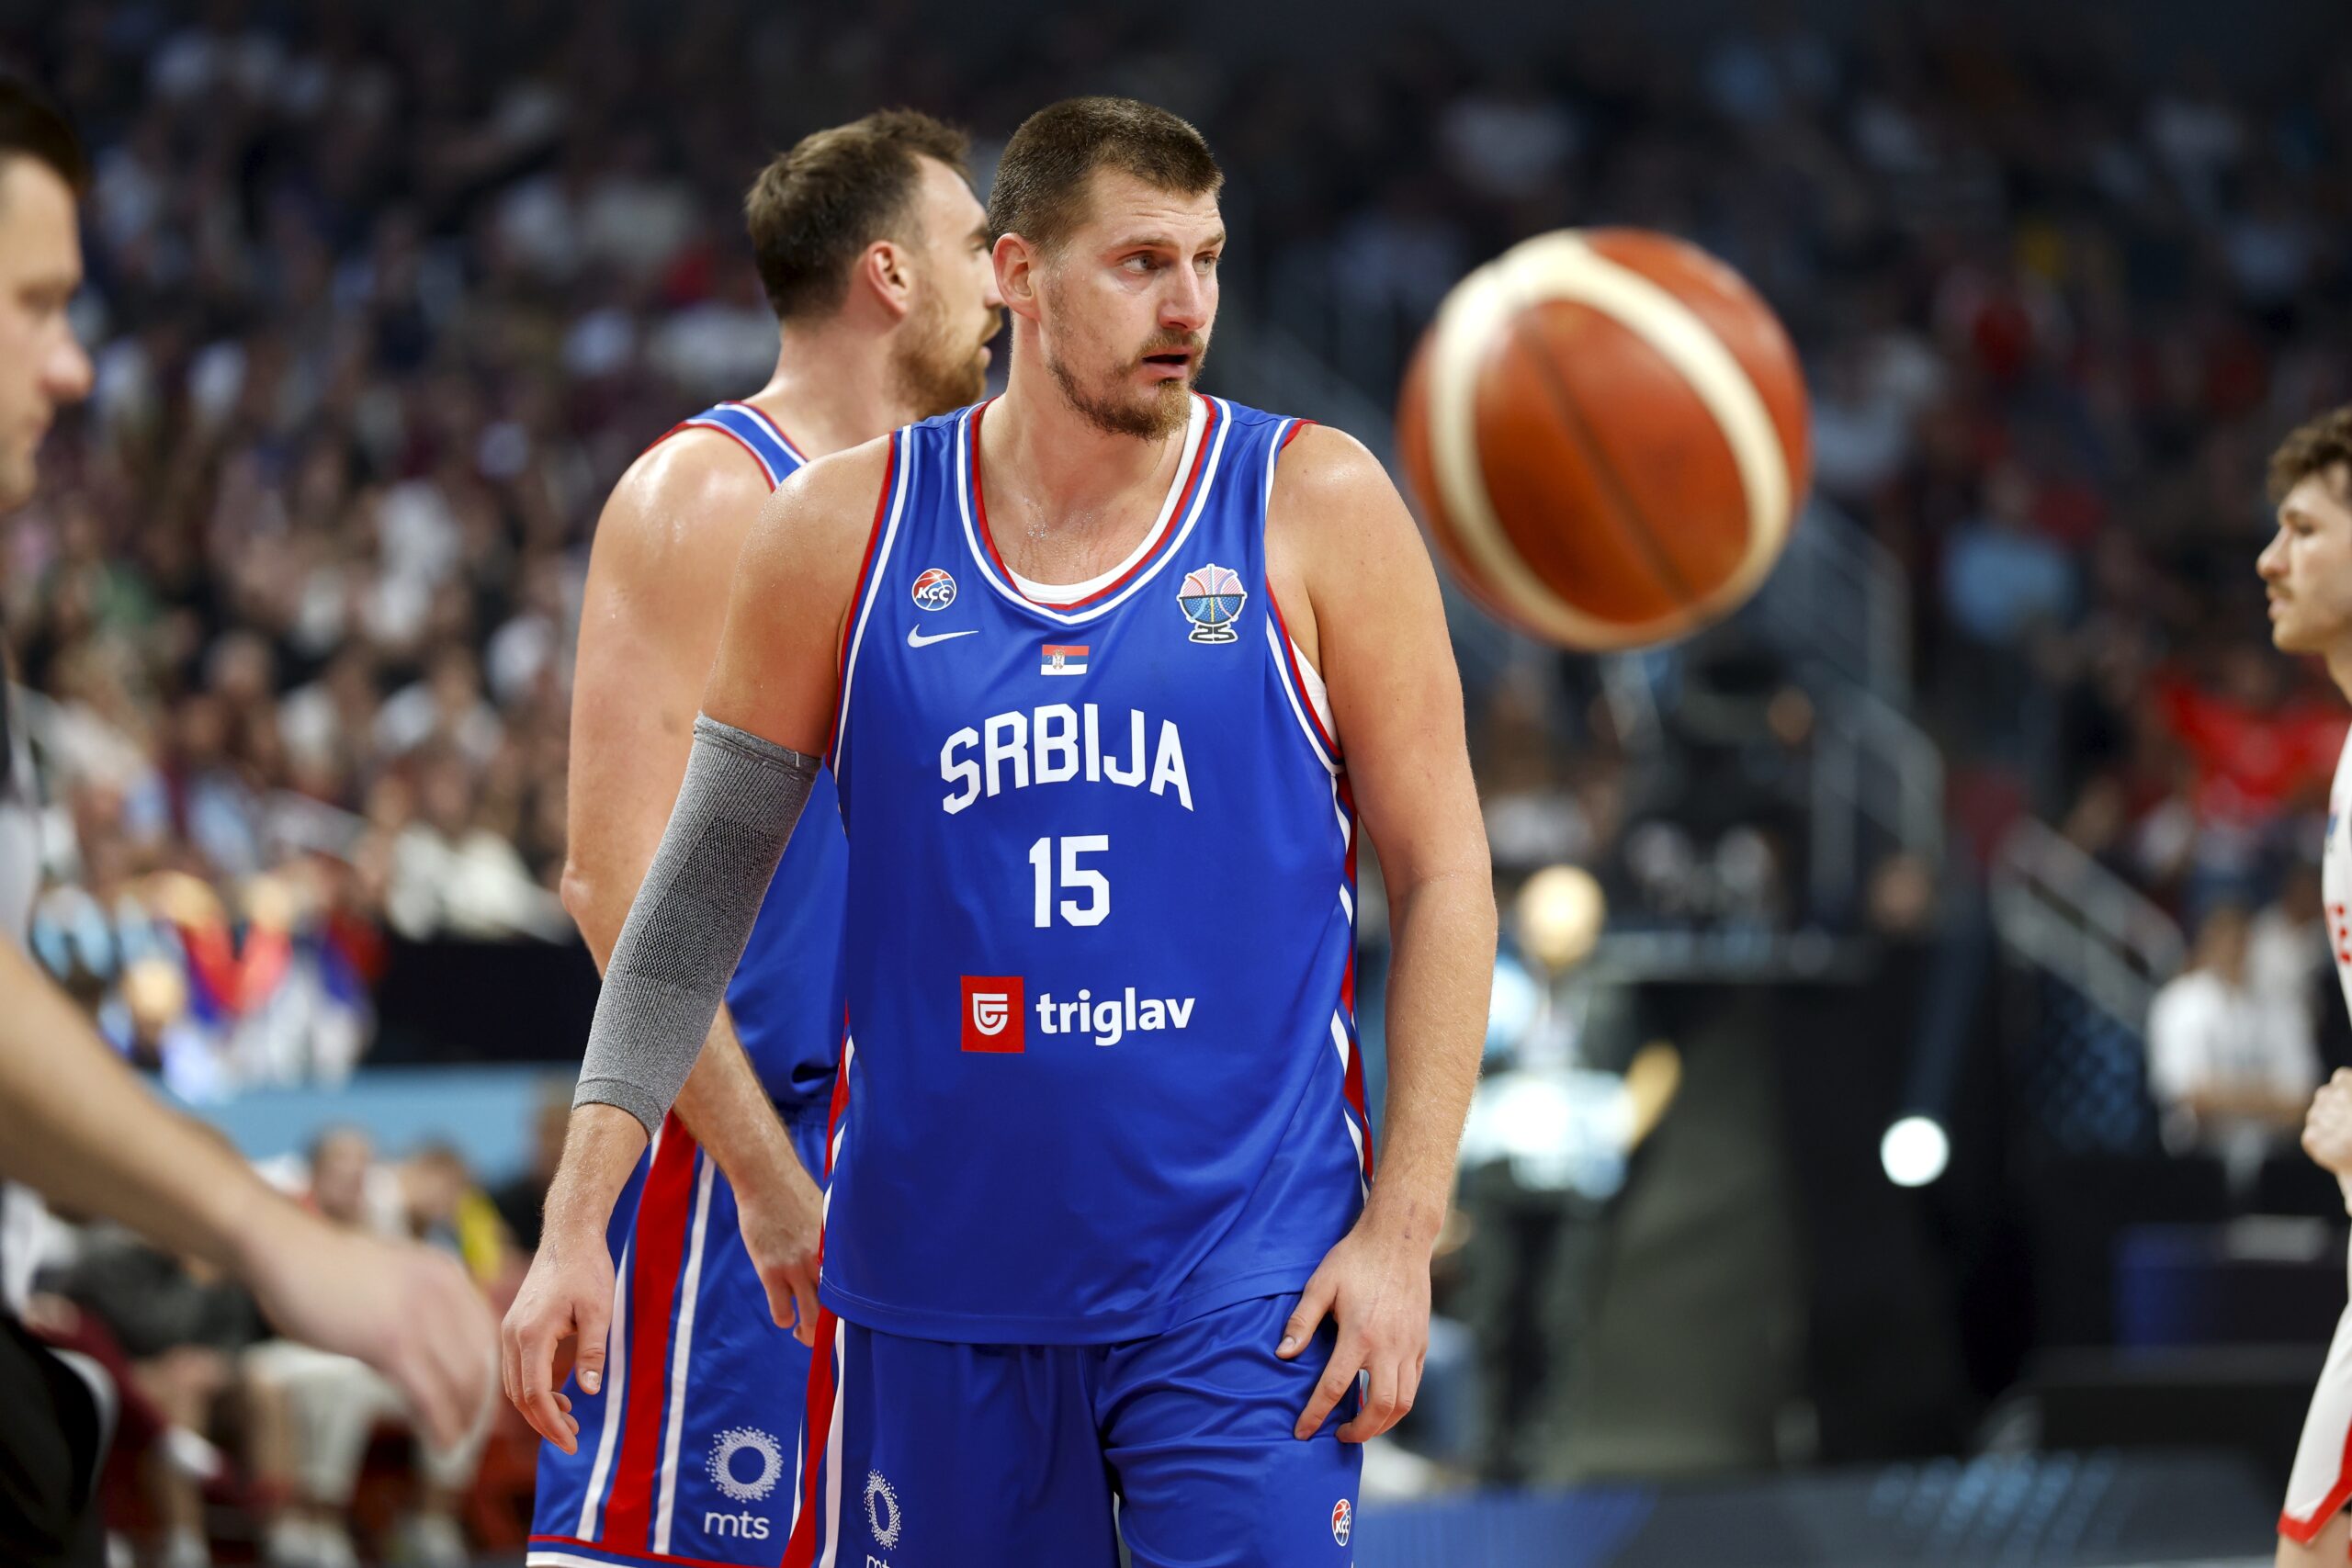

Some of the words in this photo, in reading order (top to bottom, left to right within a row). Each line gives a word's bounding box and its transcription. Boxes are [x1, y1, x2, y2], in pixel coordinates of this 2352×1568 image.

[940, 703, 1194, 815] SRBIJA
[1029, 834, 1110, 928] 15
[1035, 987, 1195, 1046] triglav
[704, 1510, 770, 1540] mts
